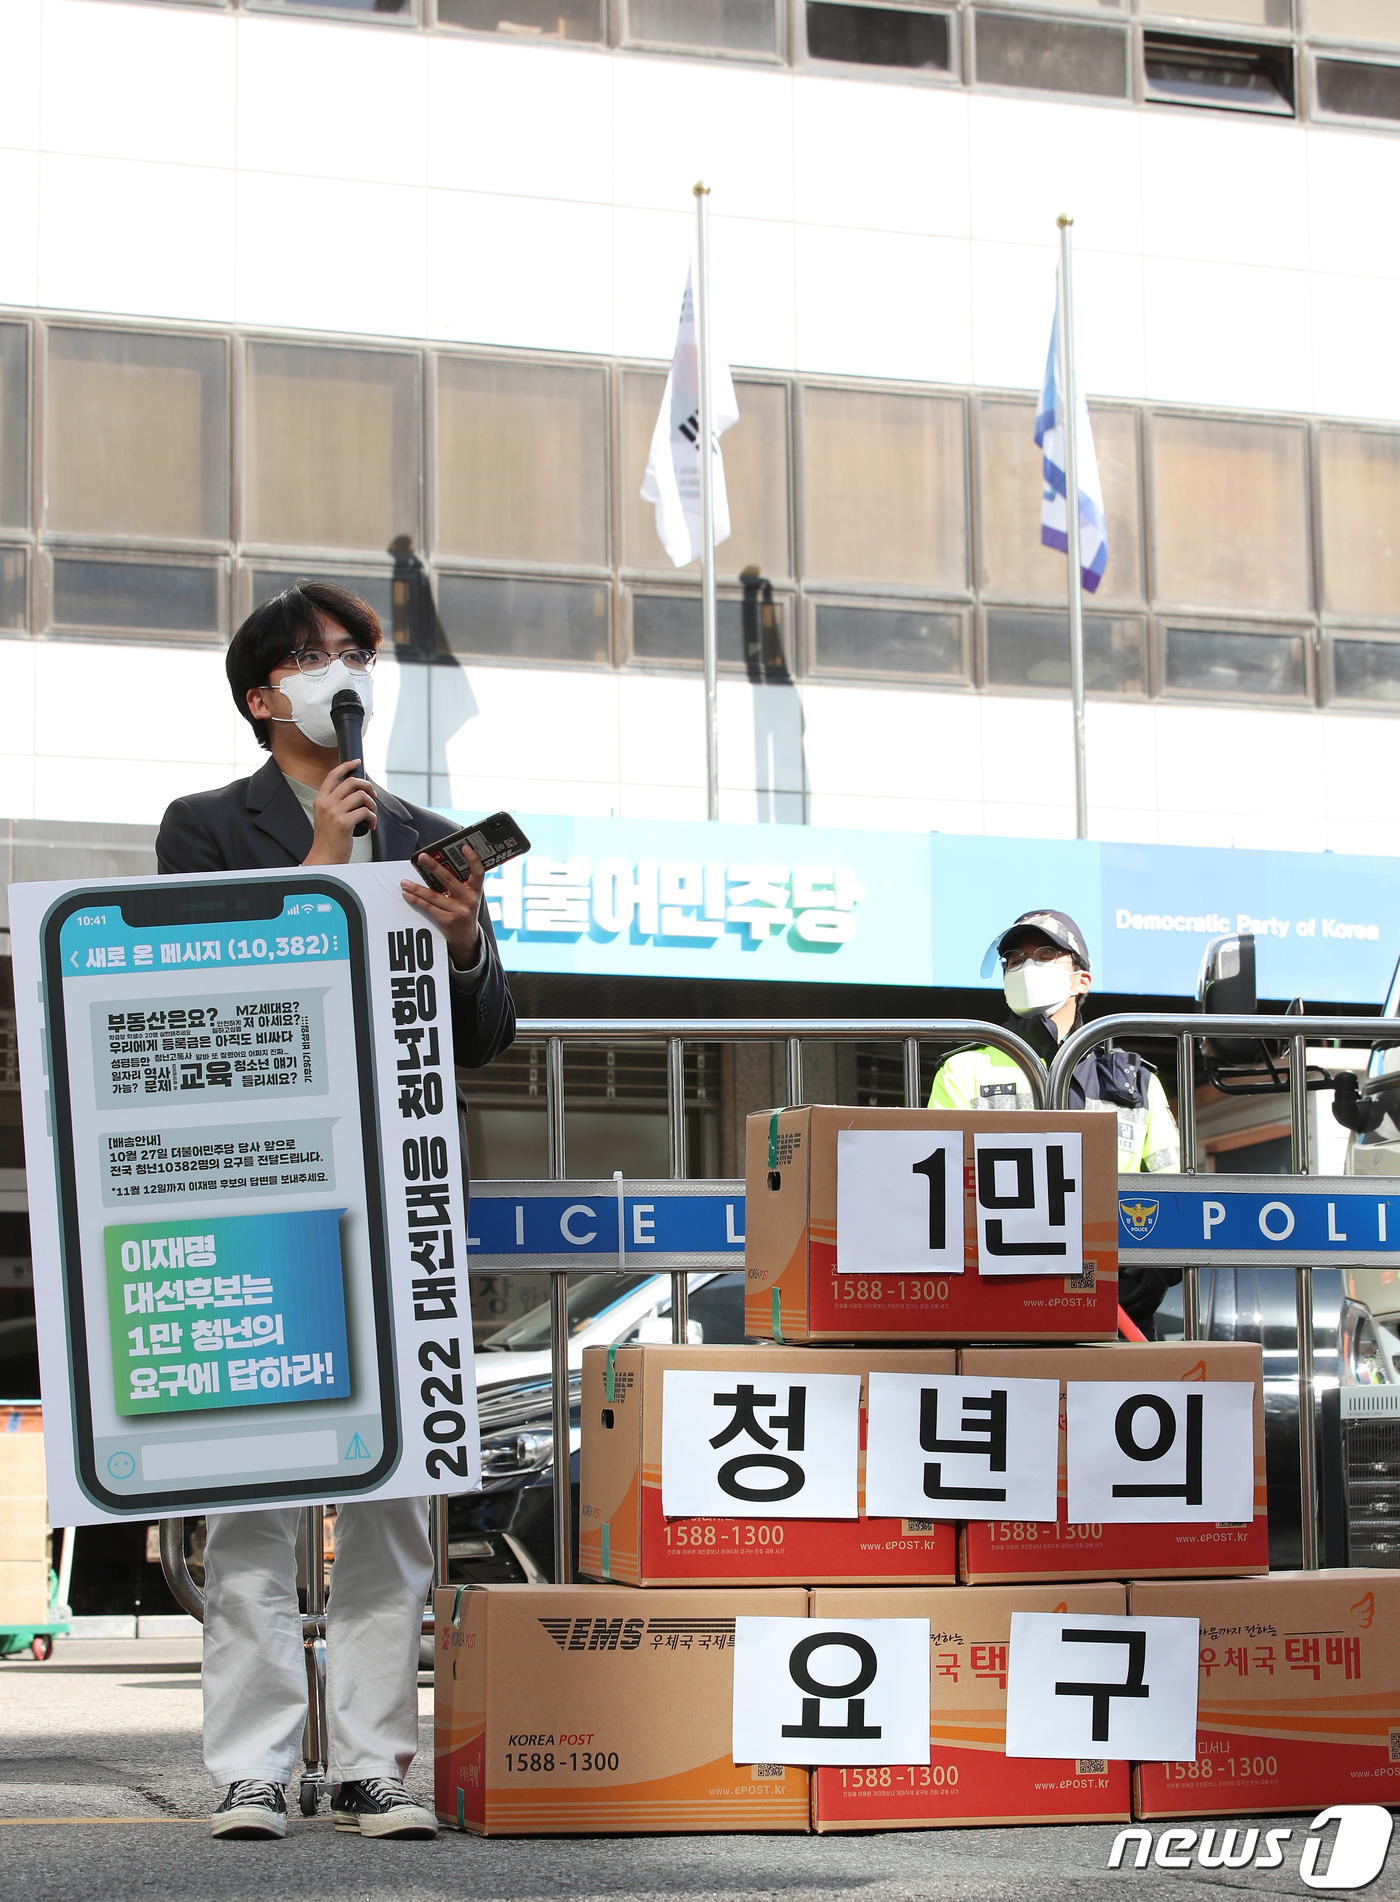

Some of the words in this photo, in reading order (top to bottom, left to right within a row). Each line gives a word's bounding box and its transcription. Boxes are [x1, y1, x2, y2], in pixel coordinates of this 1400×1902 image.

[76, 915, 107, 927] 10:41
[1115, 909, 1230, 934] Democratic
[1236, 914, 1289, 938] Party
[1296, 918, 1316, 937] of
[1322, 918, 1379, 941] Korea
[85, 946, 127, 969] 새로
[132, 944, 154, 966] 온
[160, 940, 222, 964] 메시지
[228, 932, 330, 962] (10,382)
[236, 1001, 300, 1016] MZ세대요?
[107, 1007, 219, 1033] 부동산은요?
[242, 1017, 254, 1028] 저
[258, 1013, 301, 1027] 아세요?
[387, 928, 444, 1121] 청년행동
[109, 1039, 158, 1054] 우리에게
[162, 1035, 212, 1051] 등록금은
[215, 1033, 252, 1047] 아직도
[256, 1030, 294, 1045] 비싸다
[110, 1056, 151, 1069] 성평등한
[144, 1066, 171, 1080] 역사
[233, 1057, 270, 1072] 청소년
[273, 1056, 298, 1070] 얘기
[111, 1070, 141, 1081] 일자리
[180, 1060, 233, 1090] 교육
[241, 1072, 298, 1088] 들리세요?
[112, 1083, 138, 1094] 가능?
[144, 1079, 172, 1093] 문제
[108, 1134, 162, 1149] [배송안내]
[109, 1150, 138, 1163] 10월
[140, 1148, 168, 1160] 27일
[171, 1143, 235, 1158] 더불어민주당
[238, 1141, 261, 1154] 당사
[263, 1138, 296, 1152] 앞으로
[110, 1164, 133, 1177] 전국
[135, 1158, 220, 1175] 청년10382명의
[223, 1155, 254, 1169] 요구를
[257, 1151, 324, 1167] 전달드립니다.
[143, 1181, 187, 1195] 12일까지
[188, 1179, 218, 1191] 이재명
[220, 1177, 247, 1189] 후보의
[249, 1175, 278, 1187] 답변을
[280, 1172, 329, 1185] 보내주세요.
[912, 1145, 1077, 1257] 1만
[402, 1136, 459, 1322] 대선대응
[1202, 1200, 1387, 1242] POLI
[120, 1234, 218, 1272] 이재명
[123, 1274, 274, 1315] 대선후보는
[830, 1279, 950, 1301] 1588-1300
[1023, 1297, 1098, 1308] www.ePOST.kr
[127, 1322, 184, 1357] 1만
[190, 1313, 285, 1352] 청년의
[129, 1361, 221, 1400] 요구에
[227, 1351, 335, 1392] 답하라!
[418, 1337, 469, 1480] 2022
[663, 1525, 785, 1546] 1588-1300
[986, 1521, 1104, 1542] 1588-1300
[1175, 1531, 1249, 1543] www.ePOST.kr
[860, 1539, 936, 1551] www.ePOST.kr
[465, 1633, 477, 1649] POST
[567, 1618, 645, 1651] EMS
[1244, 1623, 1279, 1639] 전하는
[649, 1633, 694, 1651] 우체국
[1199, 1646, 1277, 1677] 우체국
[1284, 1636, 1362, 1681] 택배
[507, 1734, 556, 1747] KOREA
[558, 1734, 595, 1746] POST
[505, 1751, 620, 1772] 1588-1300
[1162, 1755, 1278, 1780] 1588-1300
[838, 1765, 960, 1788] 1588-1300
[1034, 1778, 1110, 1790] www.ePOST.kr
[708, 1783, 787, 1796] www.ePOST.kr
